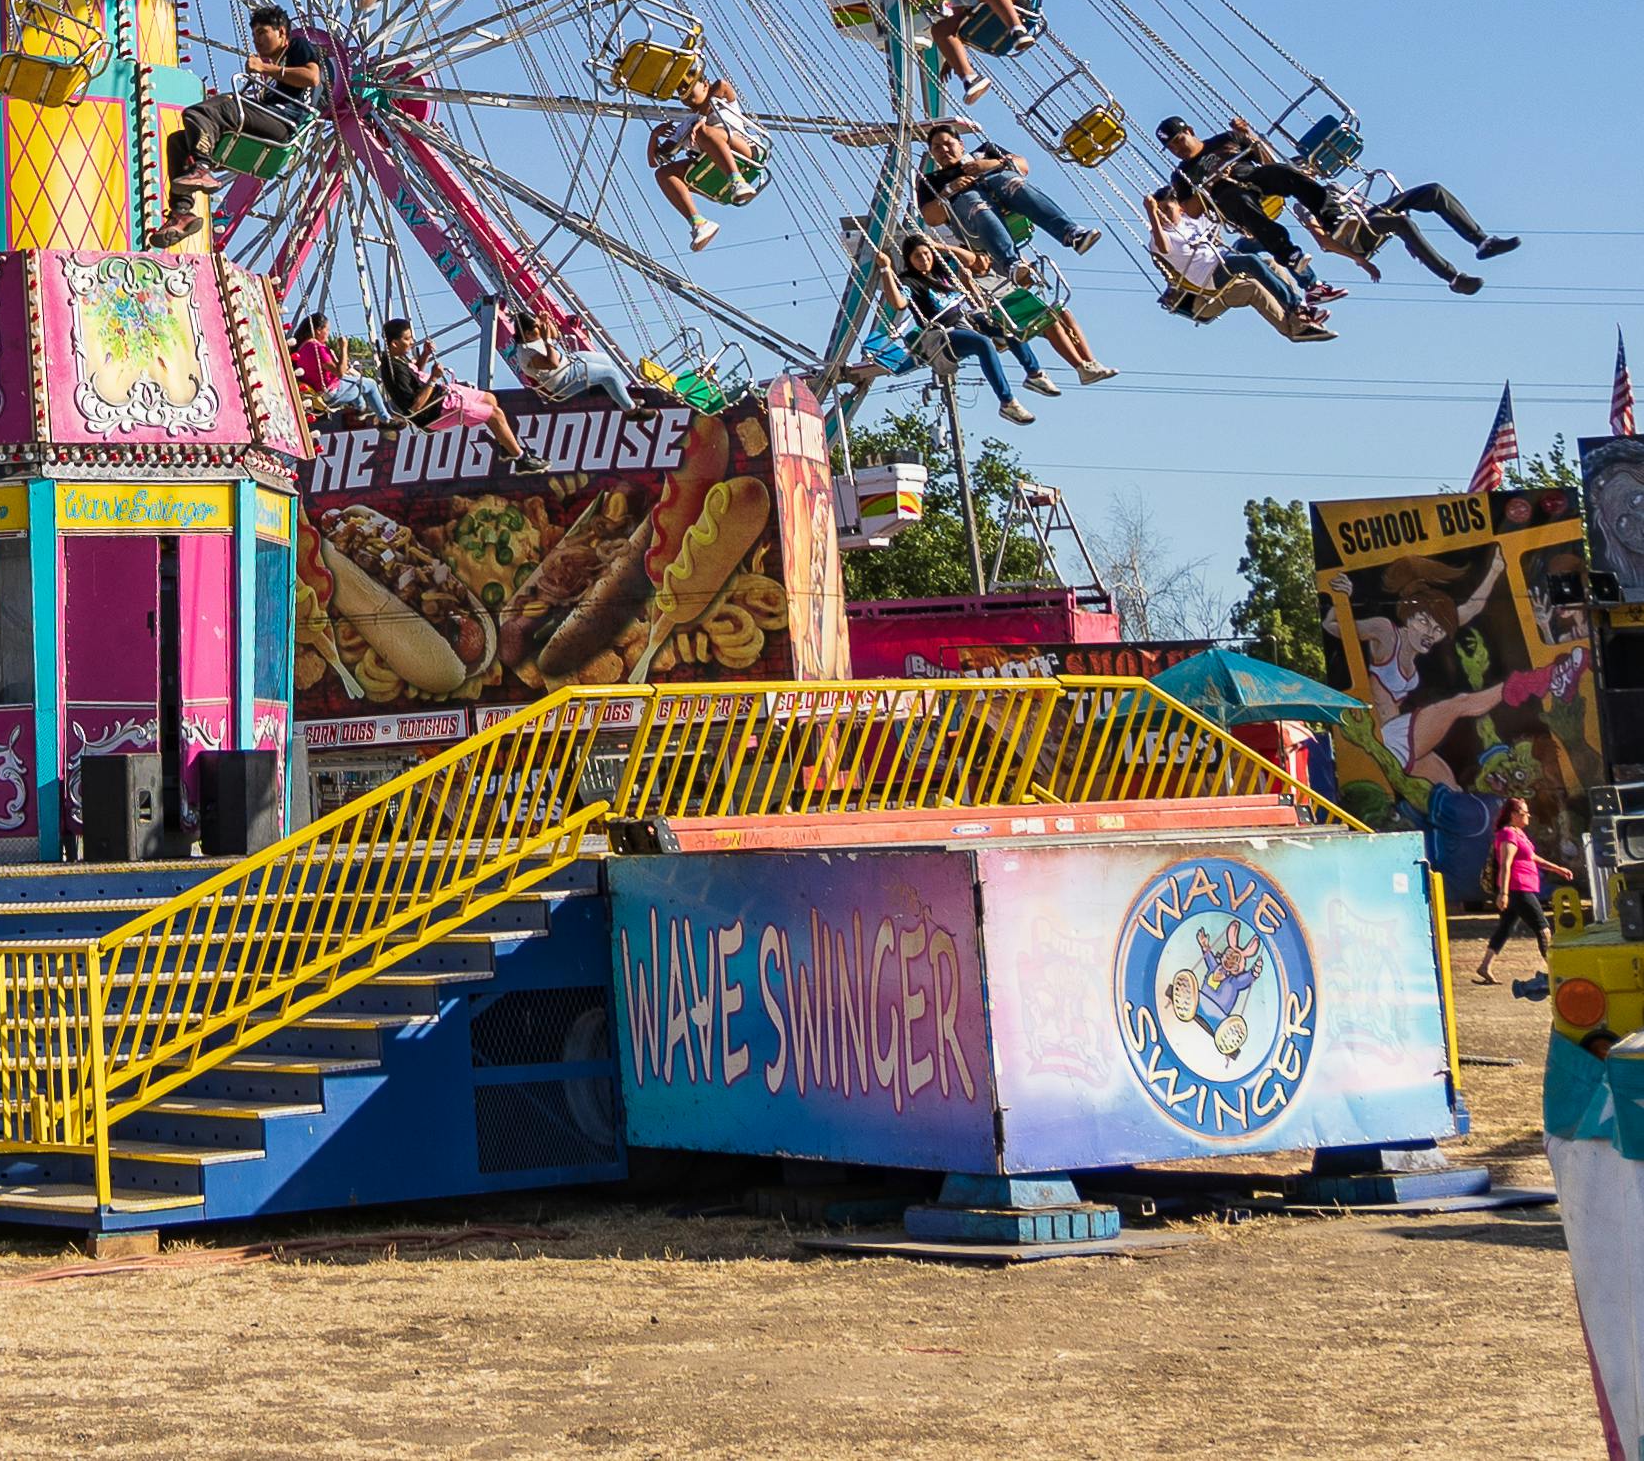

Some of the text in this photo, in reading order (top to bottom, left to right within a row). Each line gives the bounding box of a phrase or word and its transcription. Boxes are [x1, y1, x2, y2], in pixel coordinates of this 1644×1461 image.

[1338, 496, 1487, 556] SCHOOL BUS
[305, 714, 460, 746] CORN DOGS TOTCHOS
[619, 905, 976, 1115] WAVE SWINGER
[1122, 865, 1314, 1131] WAVE SWINGER
